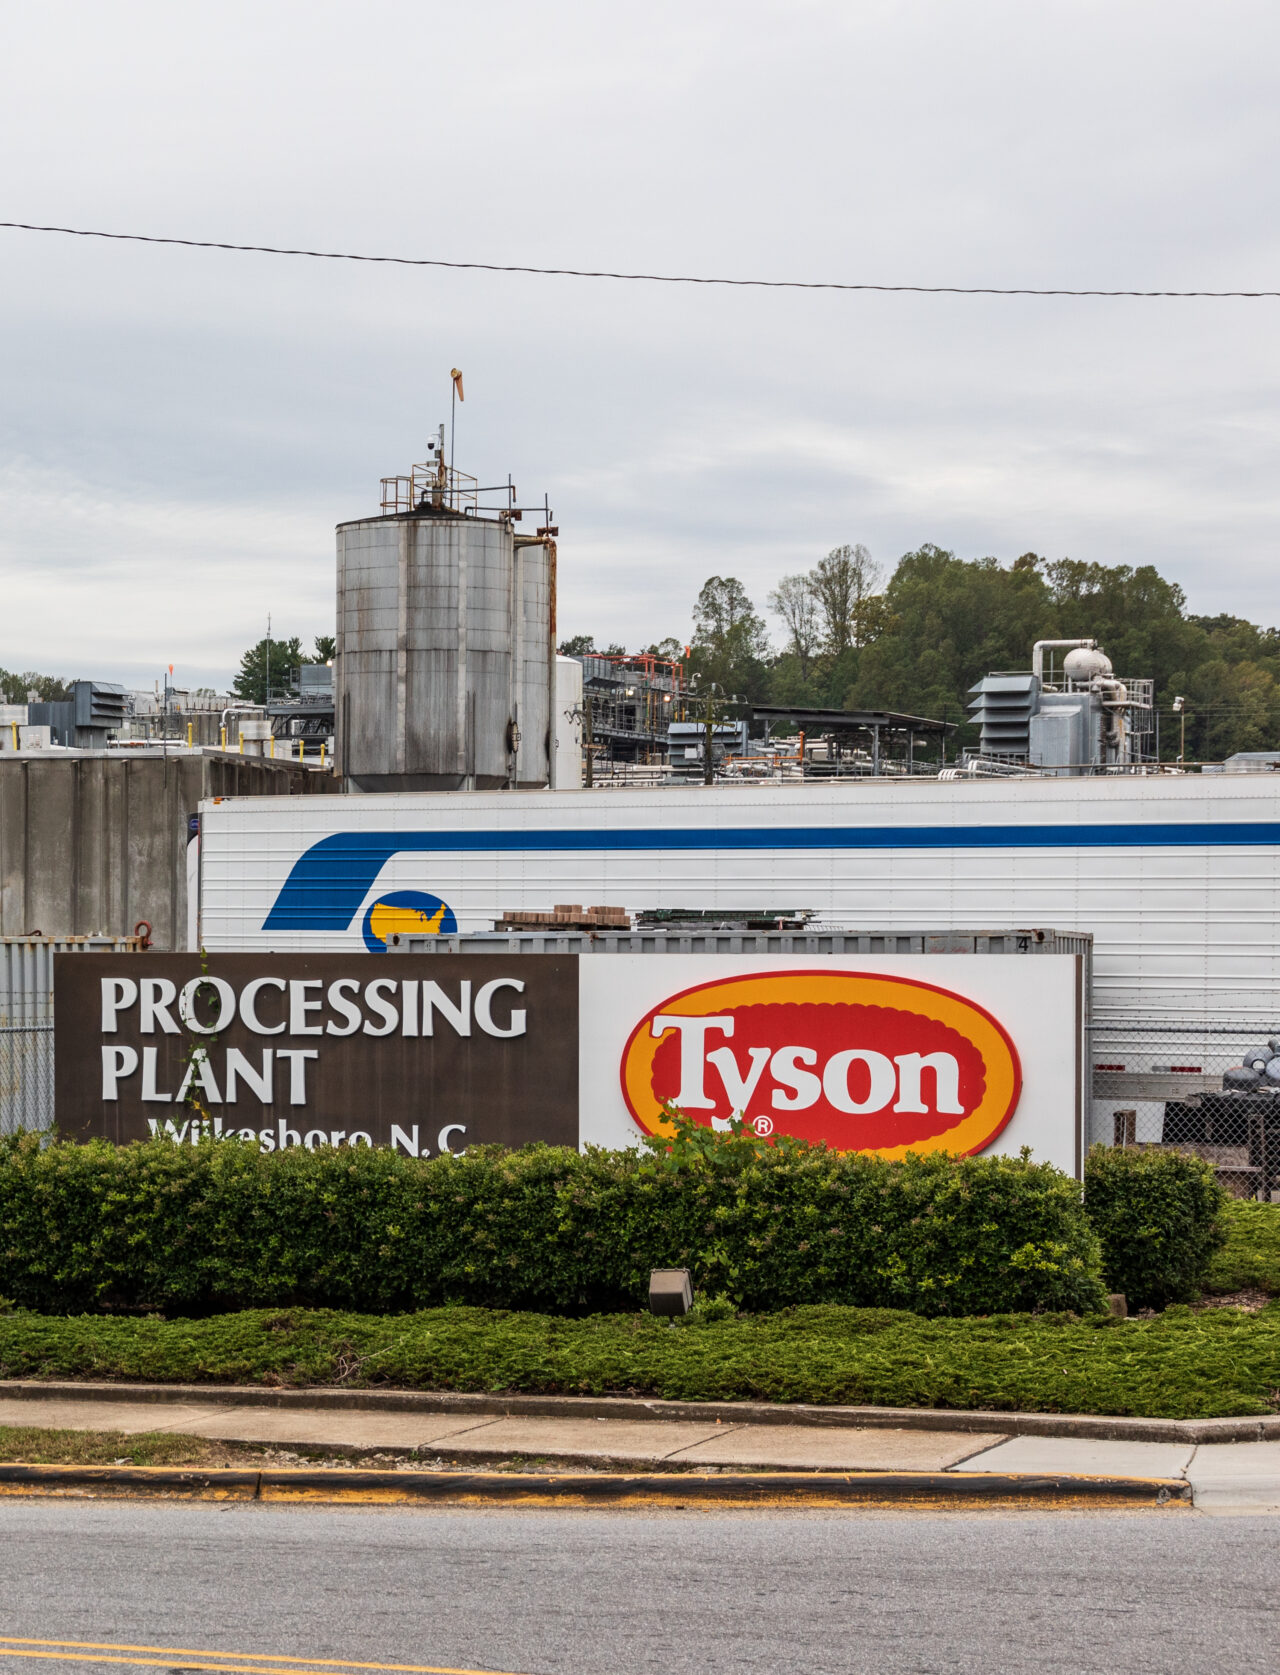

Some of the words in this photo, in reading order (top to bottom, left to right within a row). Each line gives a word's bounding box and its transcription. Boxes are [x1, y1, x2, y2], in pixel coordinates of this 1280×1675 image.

[100, 976, 527, 1039] PROCESSING
[101, 1045, 319, 1105] PLANT
[651, 1015, 965, 1133] Tyson
